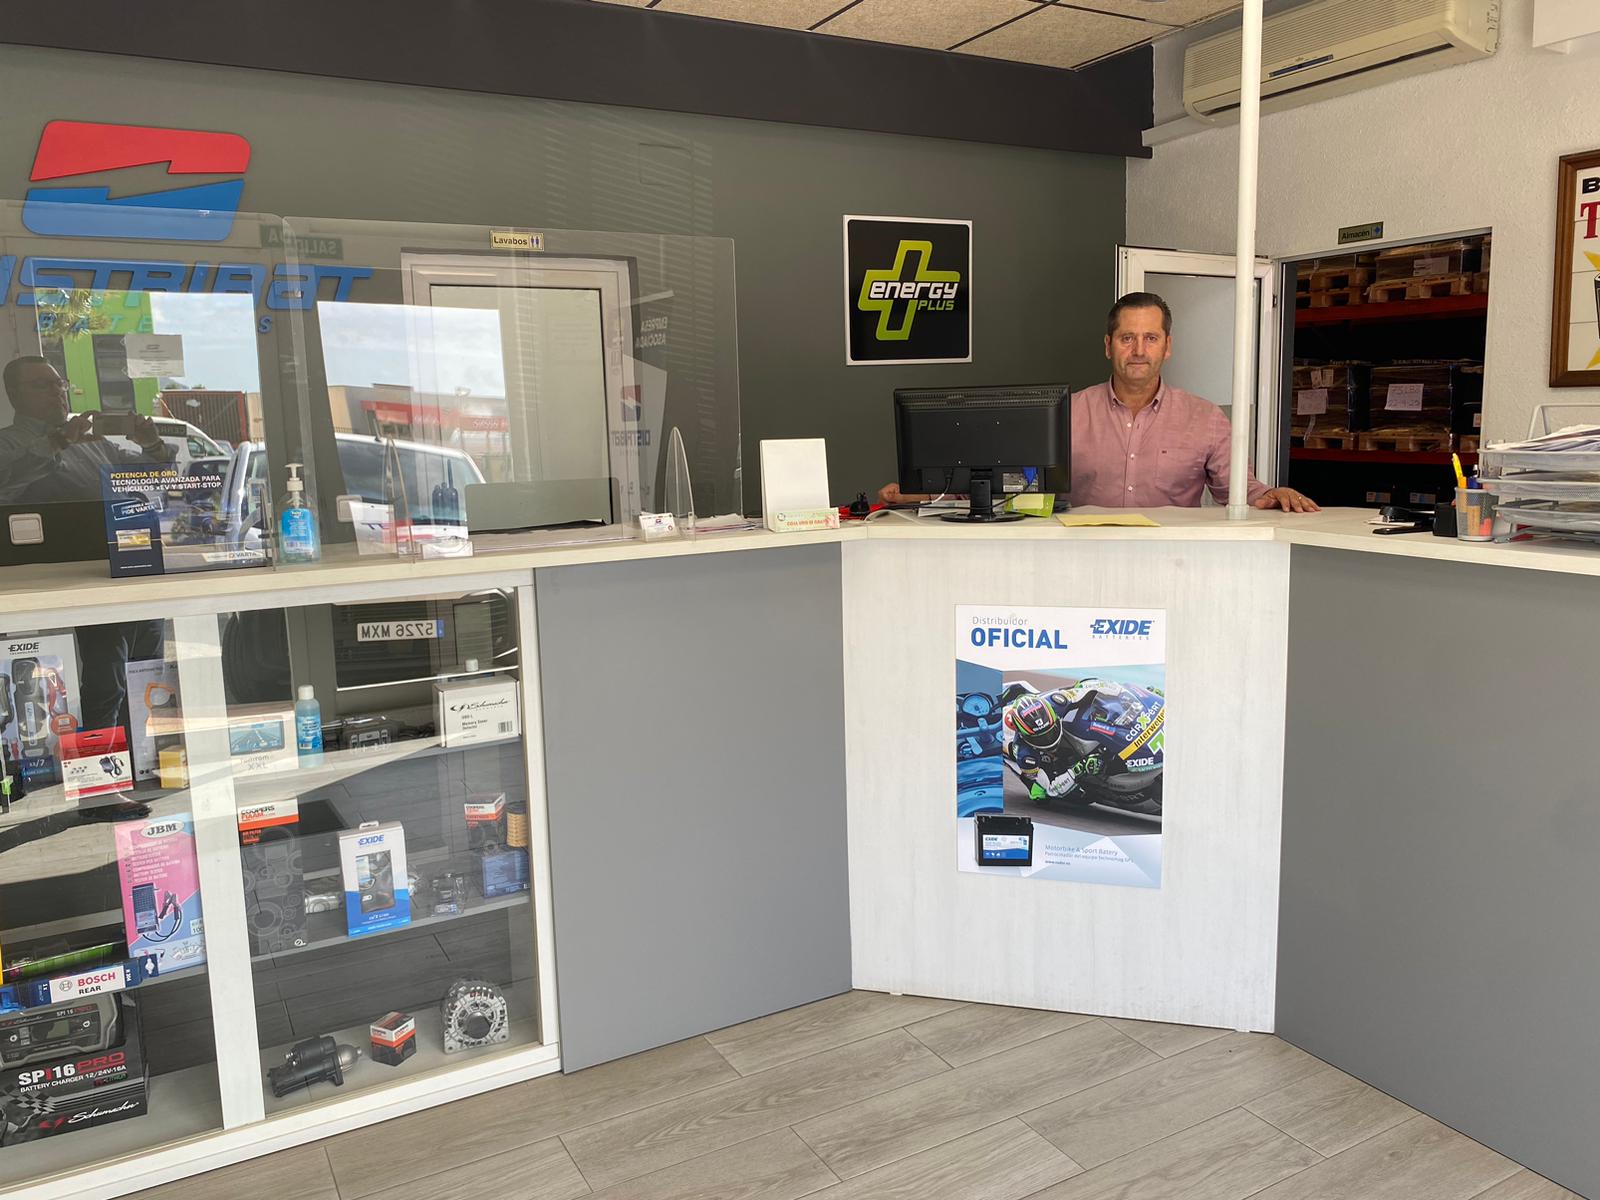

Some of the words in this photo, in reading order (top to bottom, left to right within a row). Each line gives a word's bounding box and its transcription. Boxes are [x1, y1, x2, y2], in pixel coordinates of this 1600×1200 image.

[493, 236, 528, 245] Lavabos
[917, 300, 955, 311] PLUS
[111, 478, 159, 486] TECNOLOGÍA
[161, 476, 200, 484] AVANZADA
[972, 616, 1028, 626] Distribuidor
[1090, 618, 1153, 636] EXIDE
[971, 627, 1068, 650] OFICIAL
[8, 642, 40, 652] EXIDE
[1125, 757, 1154, 768] EXIDE
[147, 823, 177, 836] JBM
[358, 834, 385, 846] EXIDE
[77, 972, 116, 987] BOSCH
[79, 986, 102, 995] REAR
[20, 1082, 51, 1093] BATTERY
[51, 1075, 84, 1087] CHARGER
